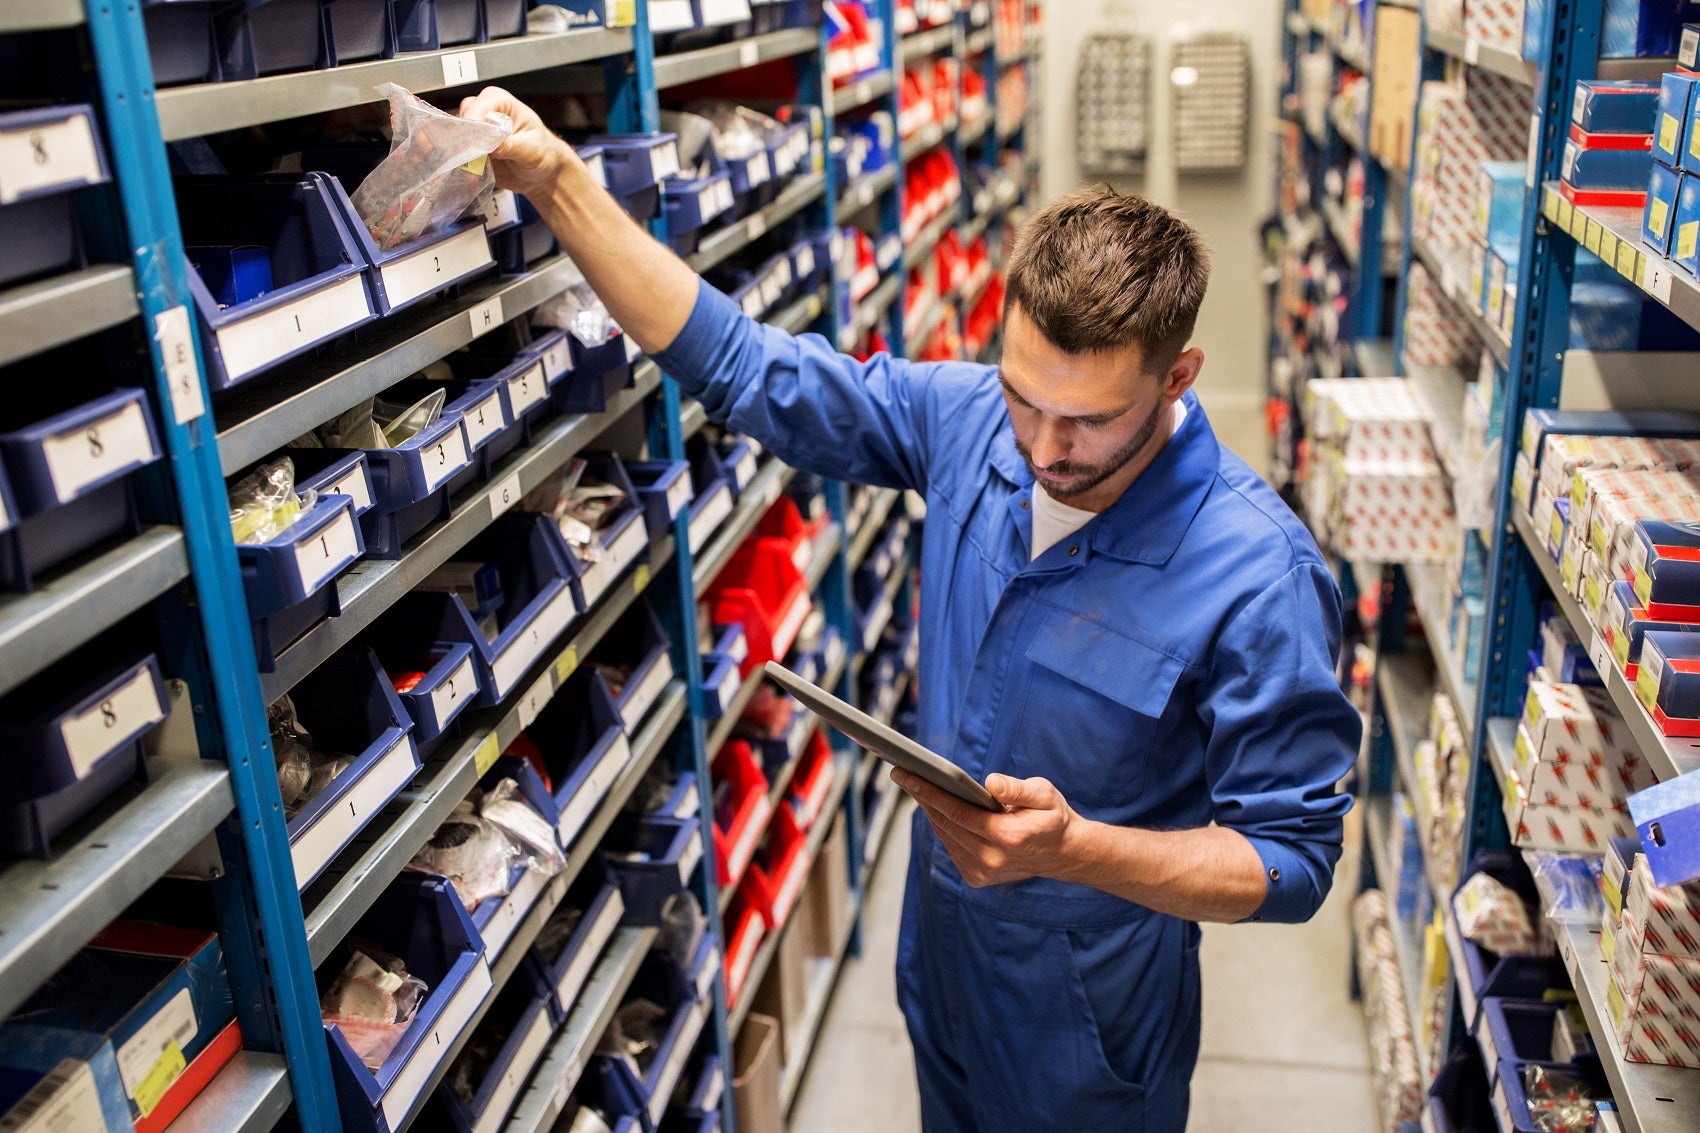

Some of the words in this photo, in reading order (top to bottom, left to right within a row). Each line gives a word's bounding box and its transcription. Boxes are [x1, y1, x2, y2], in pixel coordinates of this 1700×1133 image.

[30, 131, 48, 164] 8
[434, 256, 440, 273] 2
[1653, 271, 1659, 289] F
[295, 314, 302, 332] 1
[484, 309, 491, 326] H
[181, 375, 191, 395] 8
[521, 375, 528, 395] 5
[478, 407, 485, 426] 4
[87, 427, 104, 458] 8
[437, 443, 445, 465] 3
[502, 488, 509, 504] G
[320, 535, 329, 559] 1
[448, 679, 457, 701] 2
[100, 700, 116, 729] 8
[349, 801, 356, 817] 1
[435, 1031, 441, 1045] 1
